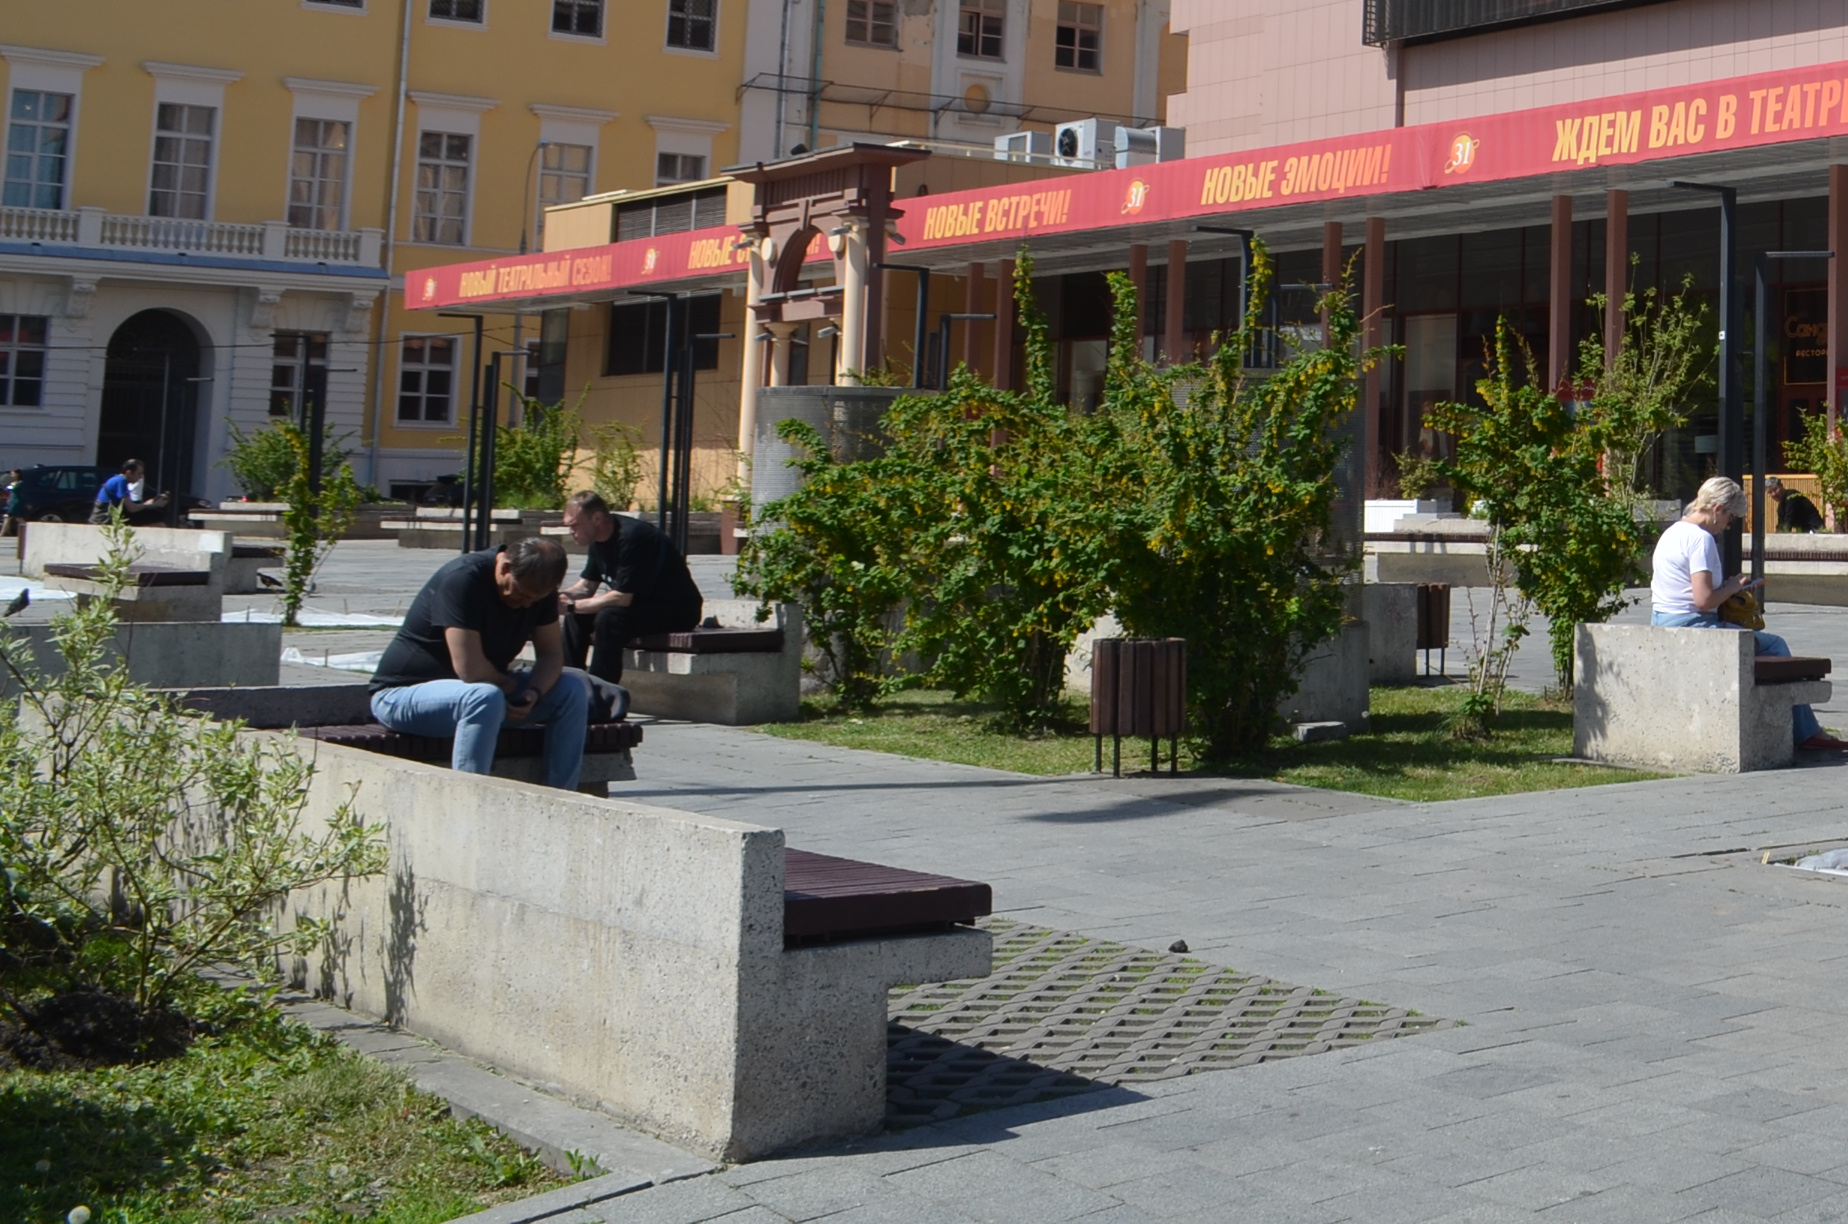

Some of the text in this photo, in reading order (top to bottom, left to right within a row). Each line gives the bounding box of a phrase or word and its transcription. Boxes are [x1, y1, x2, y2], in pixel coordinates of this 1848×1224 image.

[1552, 110, 1642, 164] ЖДЕМ
[1648, 97, 1707, 149] ВАС
[1715, 94, 1737, 139] В
[1200, 144, 1392, 205] НОВЫЕ ЭМОЦИИ!
[1452, 142, 1473, 167] 31
[923, 189, 1072, 240] НОВЫЕ ВСТРЕЧИ!
[1127, 187, 1144, 207] 31
[688, 235, 735, 269] НОВЫЕ
[459, 254, 612, 298] НОВЫЙ ТЕАТРАЛЬНЫЙ СЕЗОН!
